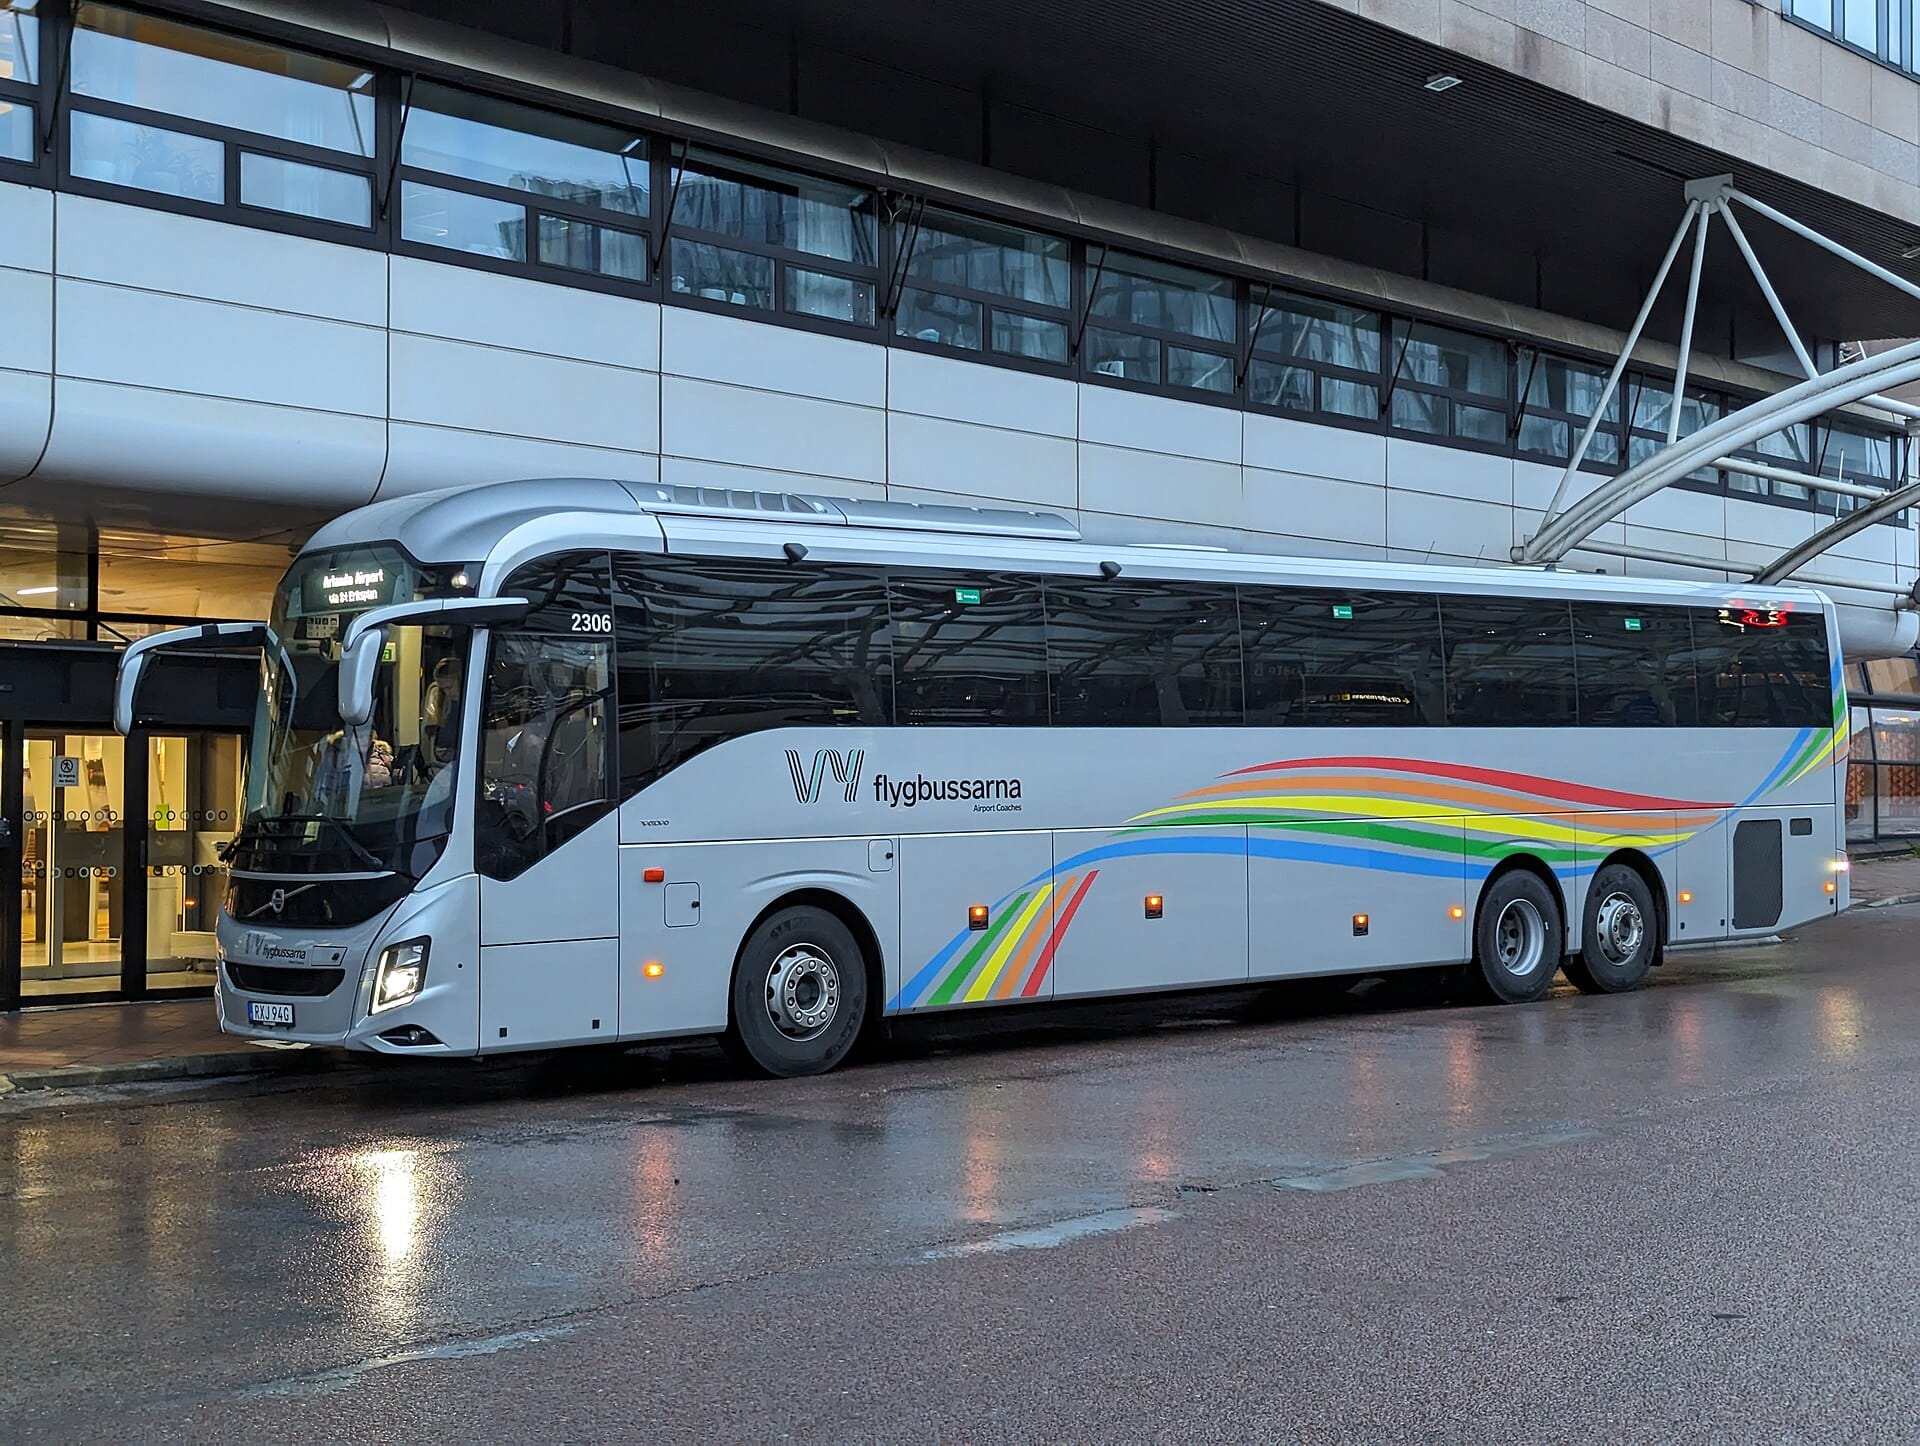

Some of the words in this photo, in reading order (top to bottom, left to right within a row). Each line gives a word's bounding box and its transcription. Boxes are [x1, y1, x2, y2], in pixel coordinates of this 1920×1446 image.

[355, 568, 384, 587] Airport
[571, 613, 612, 632] 2306
[873, 774, 1022, 807] flygbussarna
[973, 804, 995, 813] Airport
[996, 803, 1022, 812] Coaches
[254, 1004, 270, 1020] RXJ
[271, 1006, 290, 1021] 94G
